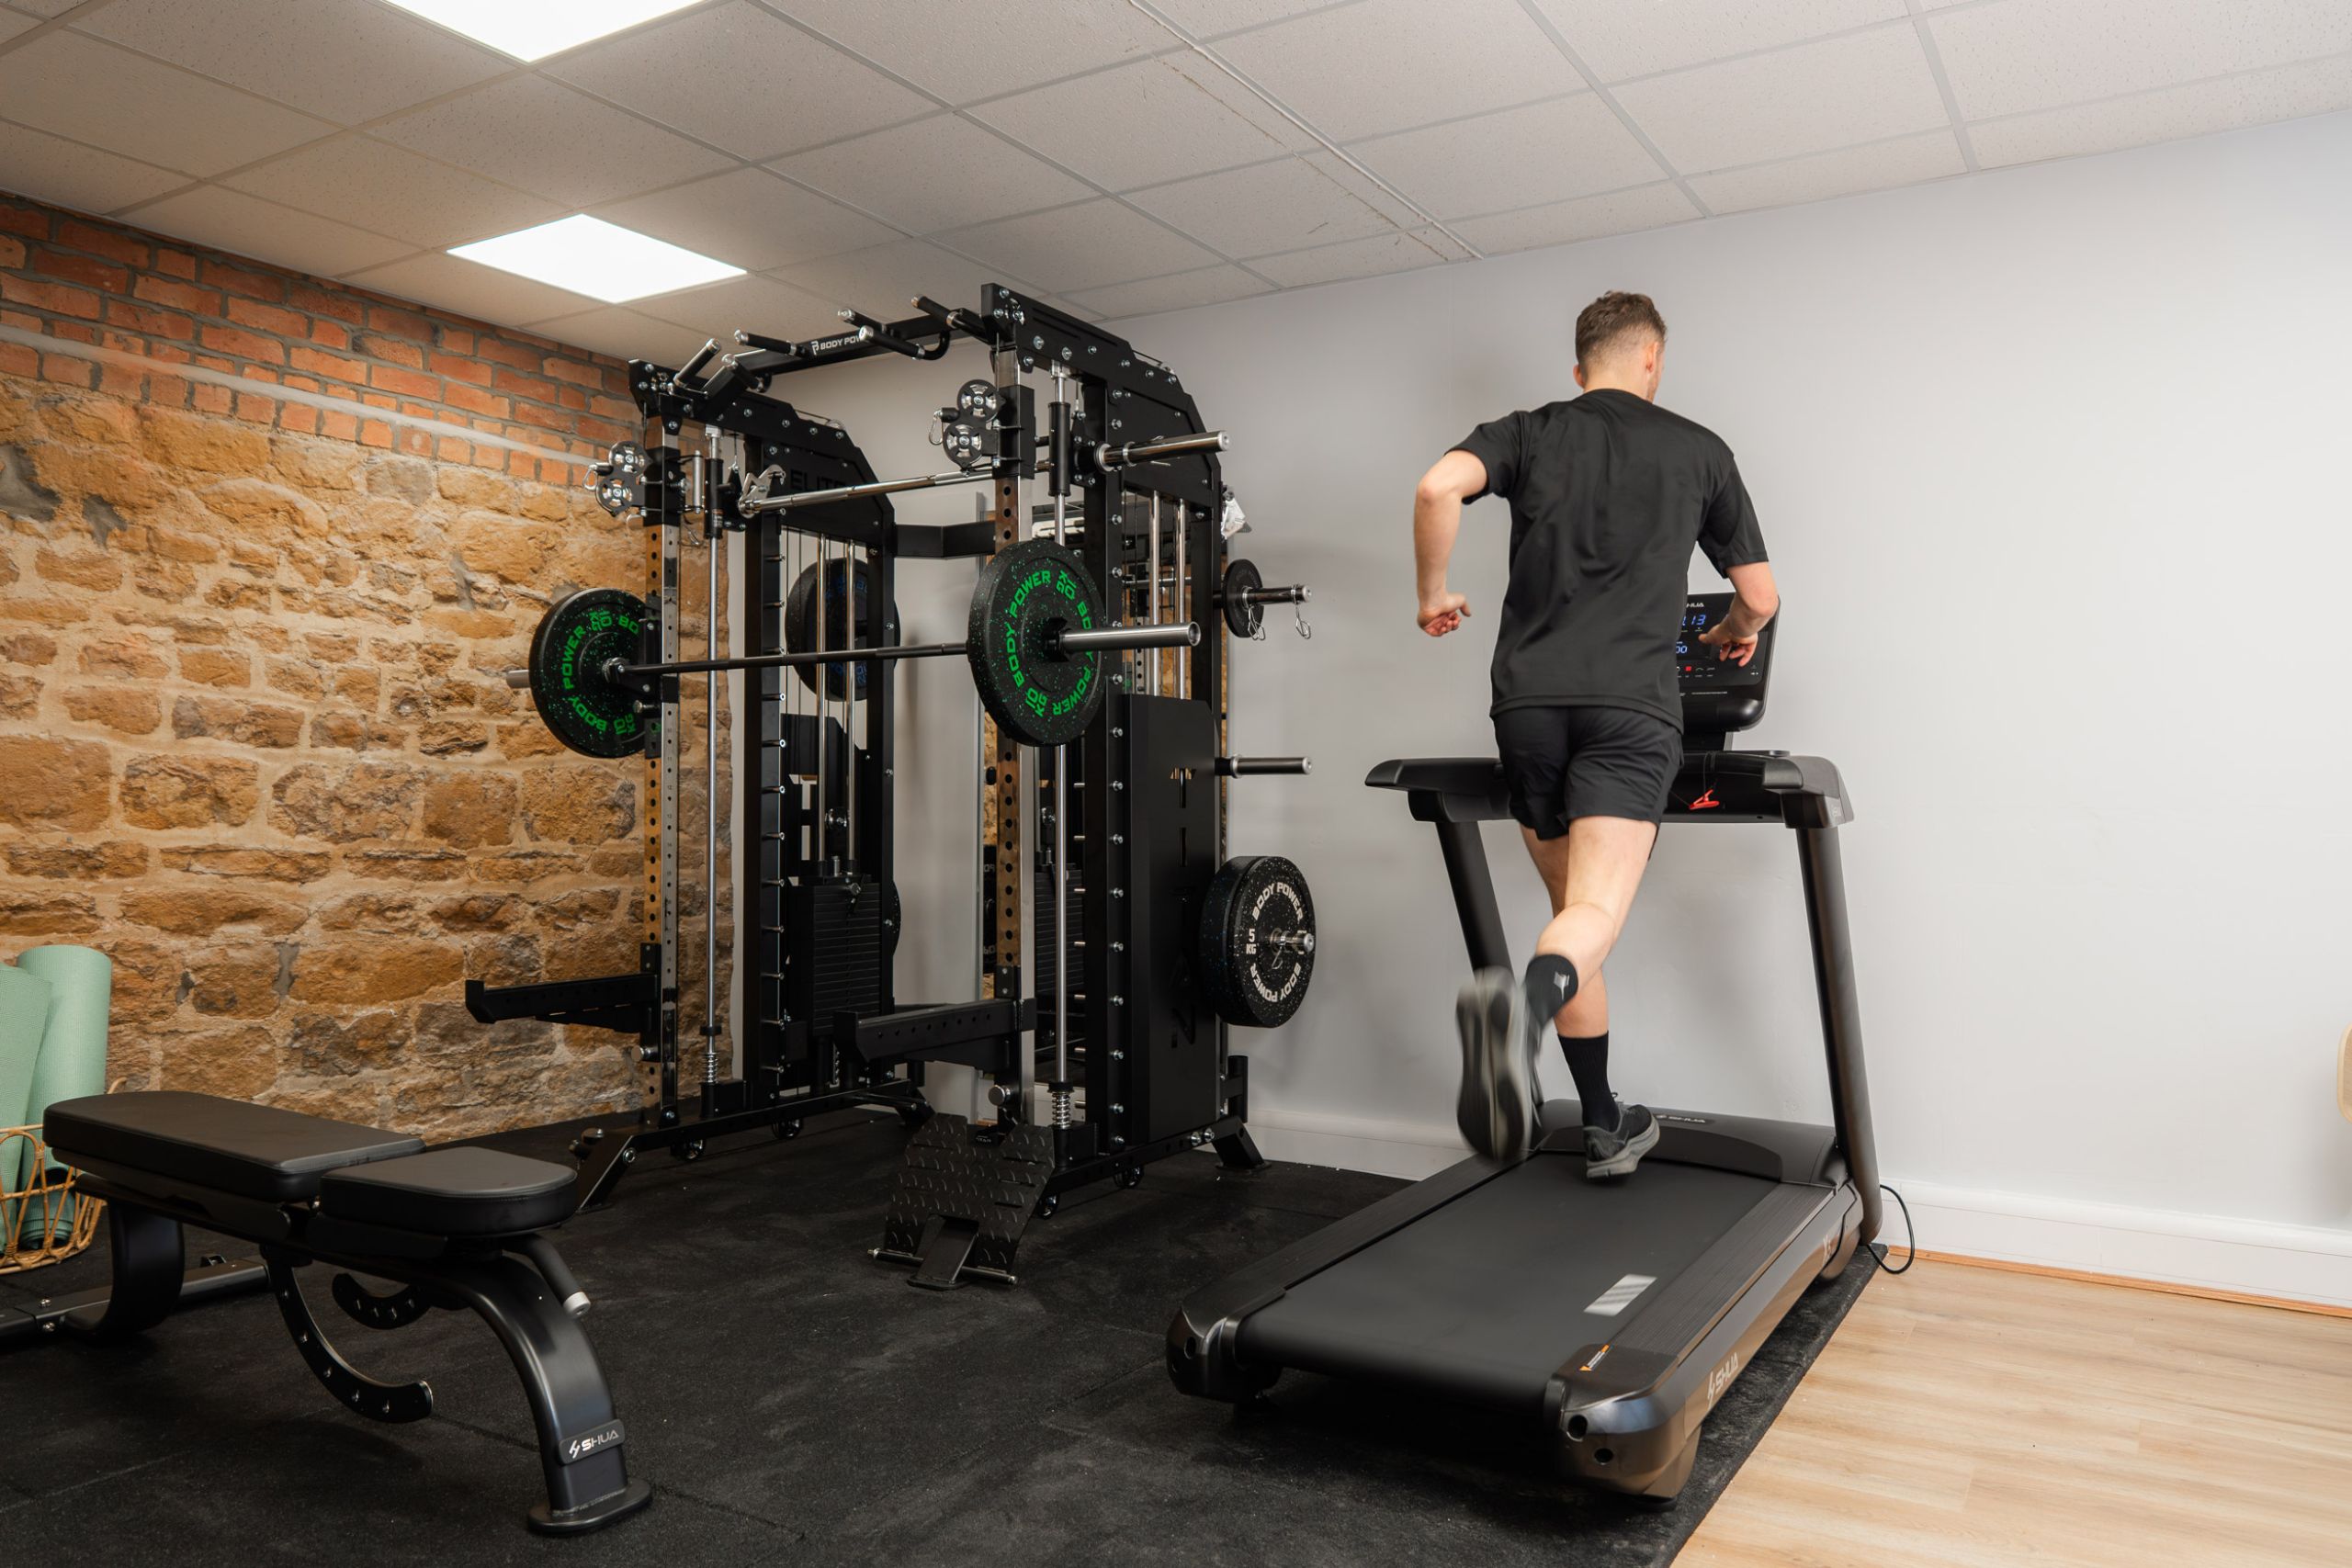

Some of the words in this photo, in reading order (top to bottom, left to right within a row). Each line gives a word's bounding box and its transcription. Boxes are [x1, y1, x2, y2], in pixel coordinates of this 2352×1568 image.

[820, 338, 843, 351] BODY
[1009, 570, 1051, 619] POWER
[561, 625, 586, 690] POWER
[1006, 622, 1025, 688] BODY
[1052, 665, 1092, 716] POWER
[568, 695, 607, 732] BODY
[1251, 883, 1274, 920] BODY
[1276, 882, 1304, 921] POWER
[1245, 942, 1257, 954] KG
[1248, 928, 1256, 942] 5
[1250, 963, 1278, 1002] POWER
[1280, 962, 1302, 1001] BODY
[581, 1429, 620, 1451] SHUA
